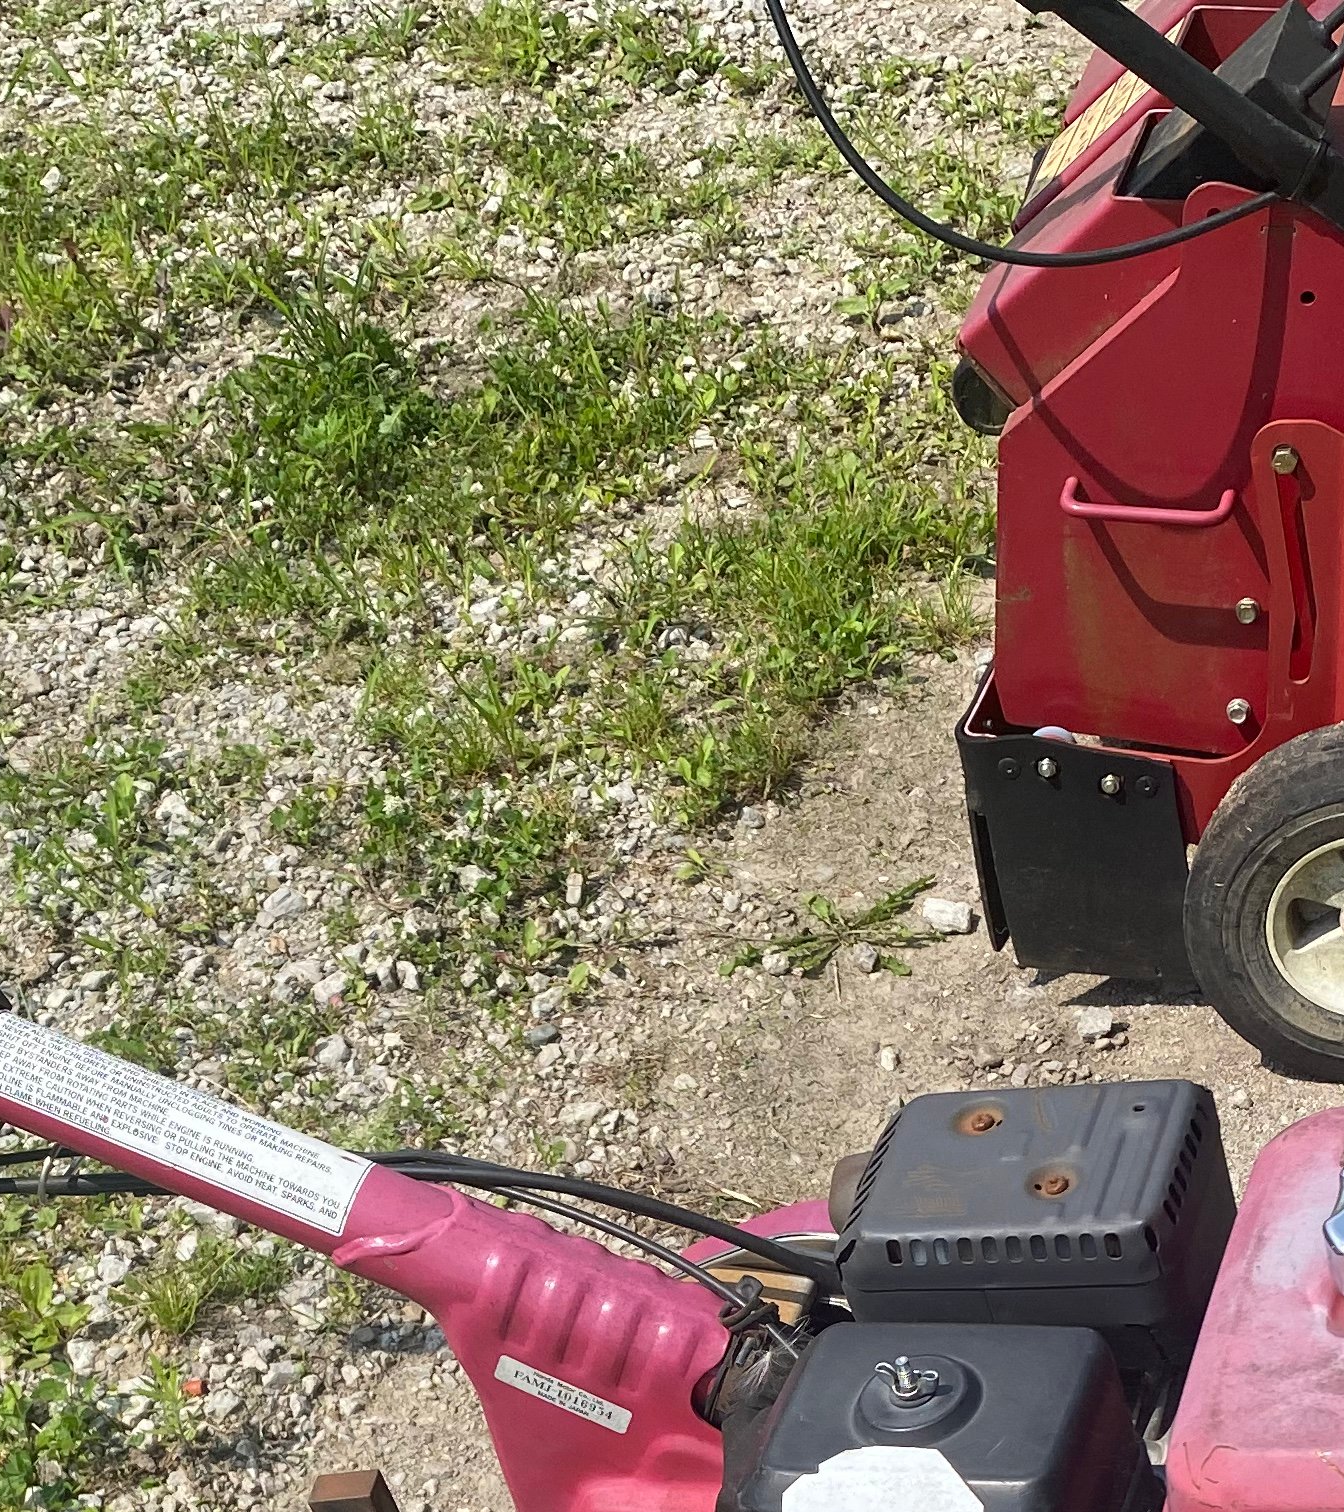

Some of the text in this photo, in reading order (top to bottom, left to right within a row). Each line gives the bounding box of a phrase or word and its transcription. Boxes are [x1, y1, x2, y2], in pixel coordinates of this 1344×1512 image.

[1, 1023, 31, 1039] NEVER
[31, 1035, 63, 1052] ALLOW
[63, 1048, 107, 1071] CHILDREN
[108, 1067, 122, 1077] OR
[190, 1101, 224, 1119] ADULTS
[224, 1115, 238, 1125] TO
[238, 1121, 278, 1141] OPERATE
[3, 1085, 33, 1102] FLAME
[33, 1097, 62, 1114] WHEN
[11, 1055, 37, 1071] AWAY
[37, 1066, 65, 1083] FROM
[65, 1077, 109, 1101] ROTATING
[109, 1096, 139, 1114] PARTS
[138, 1108, 167, 1126] WHILE
[167, 1120, 201, 1140] ENGINE
[202, 1134, 212, 1144] IS
[15, 1046, 74, 1076] BYSTANDERS
[74, 1071, 100, 1087] AWAY
[100, 1082, 128, 1098] FROM
[20, 1039, 38, 1051] OFF
[39, 1047, 73, 1065] ENGINE
[73, 1061, 109, 1080] BEFORE
[109, 1076, 156, 1100] MANUALLY
[157, 1095, 216, 1125] UNCLOGGING
[216, 1120, 243, 1136] TINES
[243, 1131, 258, 1142] OR
[258, 1137, 294, 1157] MAKING
[220, 1107, 239, 1118] AND
[1, 1062, 44, 1085] EXTREME
[44, 1080, 84, 1102] CAUTION
[84, 1097, 112, 1114] WHEN
[112, 1108, 162, 1135] REVERSING
[162, 1129, 177, 1141] OR
[177, 1135, 216, 1157] PULLING
[215, 1151, 234, 1165] THE
[234, 1159, 276, 1182] MACHINE
[276, 1177, 320, 1201] TOWARDS
[23, 1082, 35, 1092] IS
[34, 1087, 88, 1115] FLAMMABLE
[89, 1110, 110, 1124] AND
[163, 1141, 189, 1157] STOP
[225, 1167, 253, 1184] AVOID
[318, 1205, 338, 1219] AND
